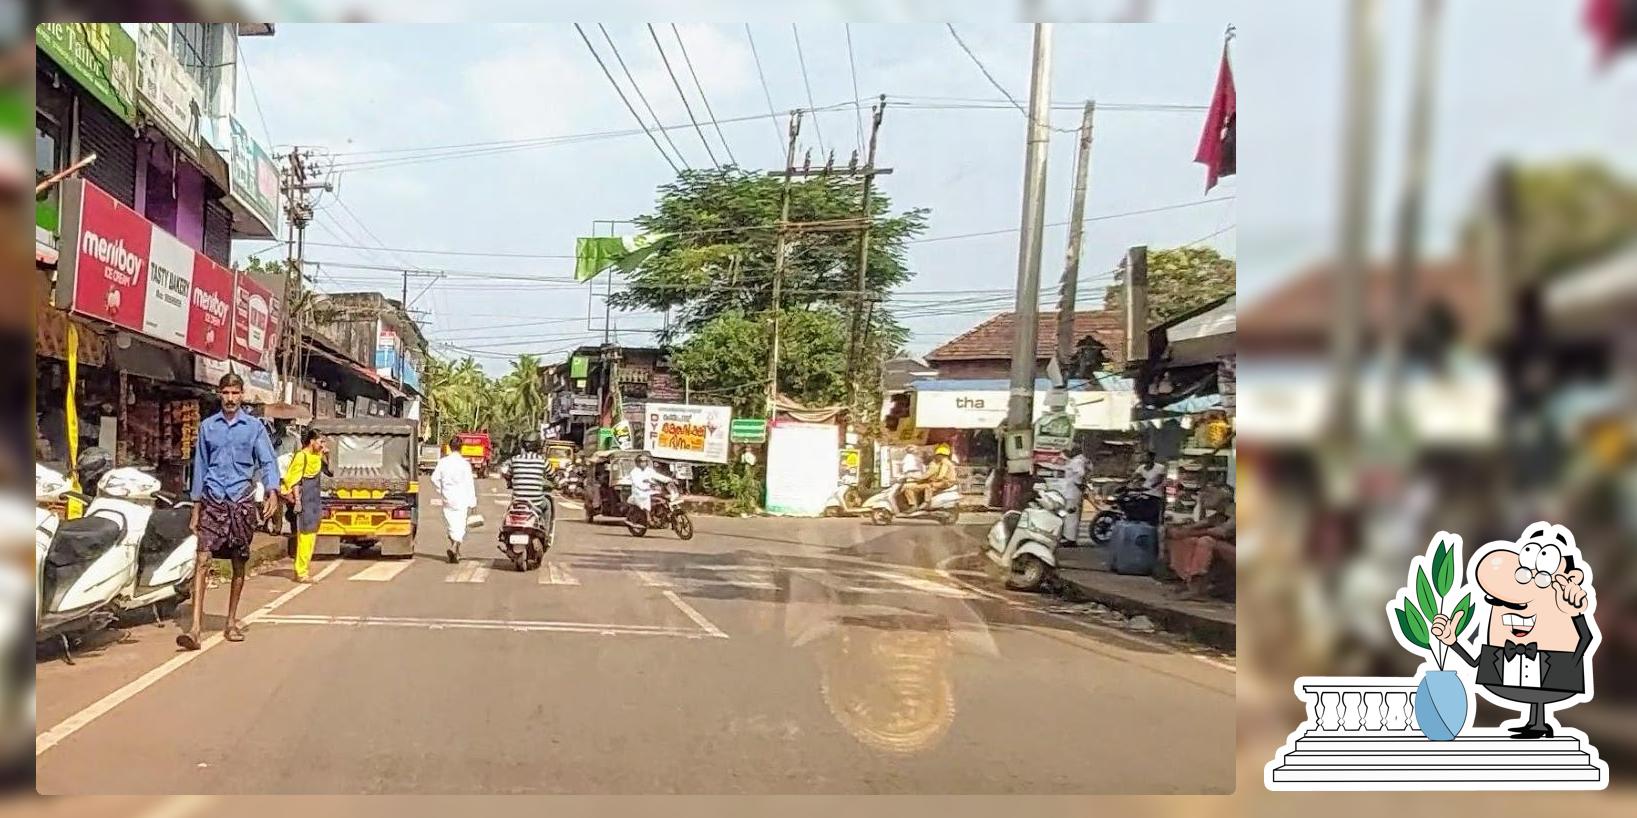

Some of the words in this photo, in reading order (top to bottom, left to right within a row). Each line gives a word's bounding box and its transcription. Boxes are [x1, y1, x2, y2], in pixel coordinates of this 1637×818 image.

[66, 26, 101, 77] Tailor
[151, 262, 169, 287] TASTY
[956, 396, 985, 409] tha
[650, 413, 659, 449] DYFI
